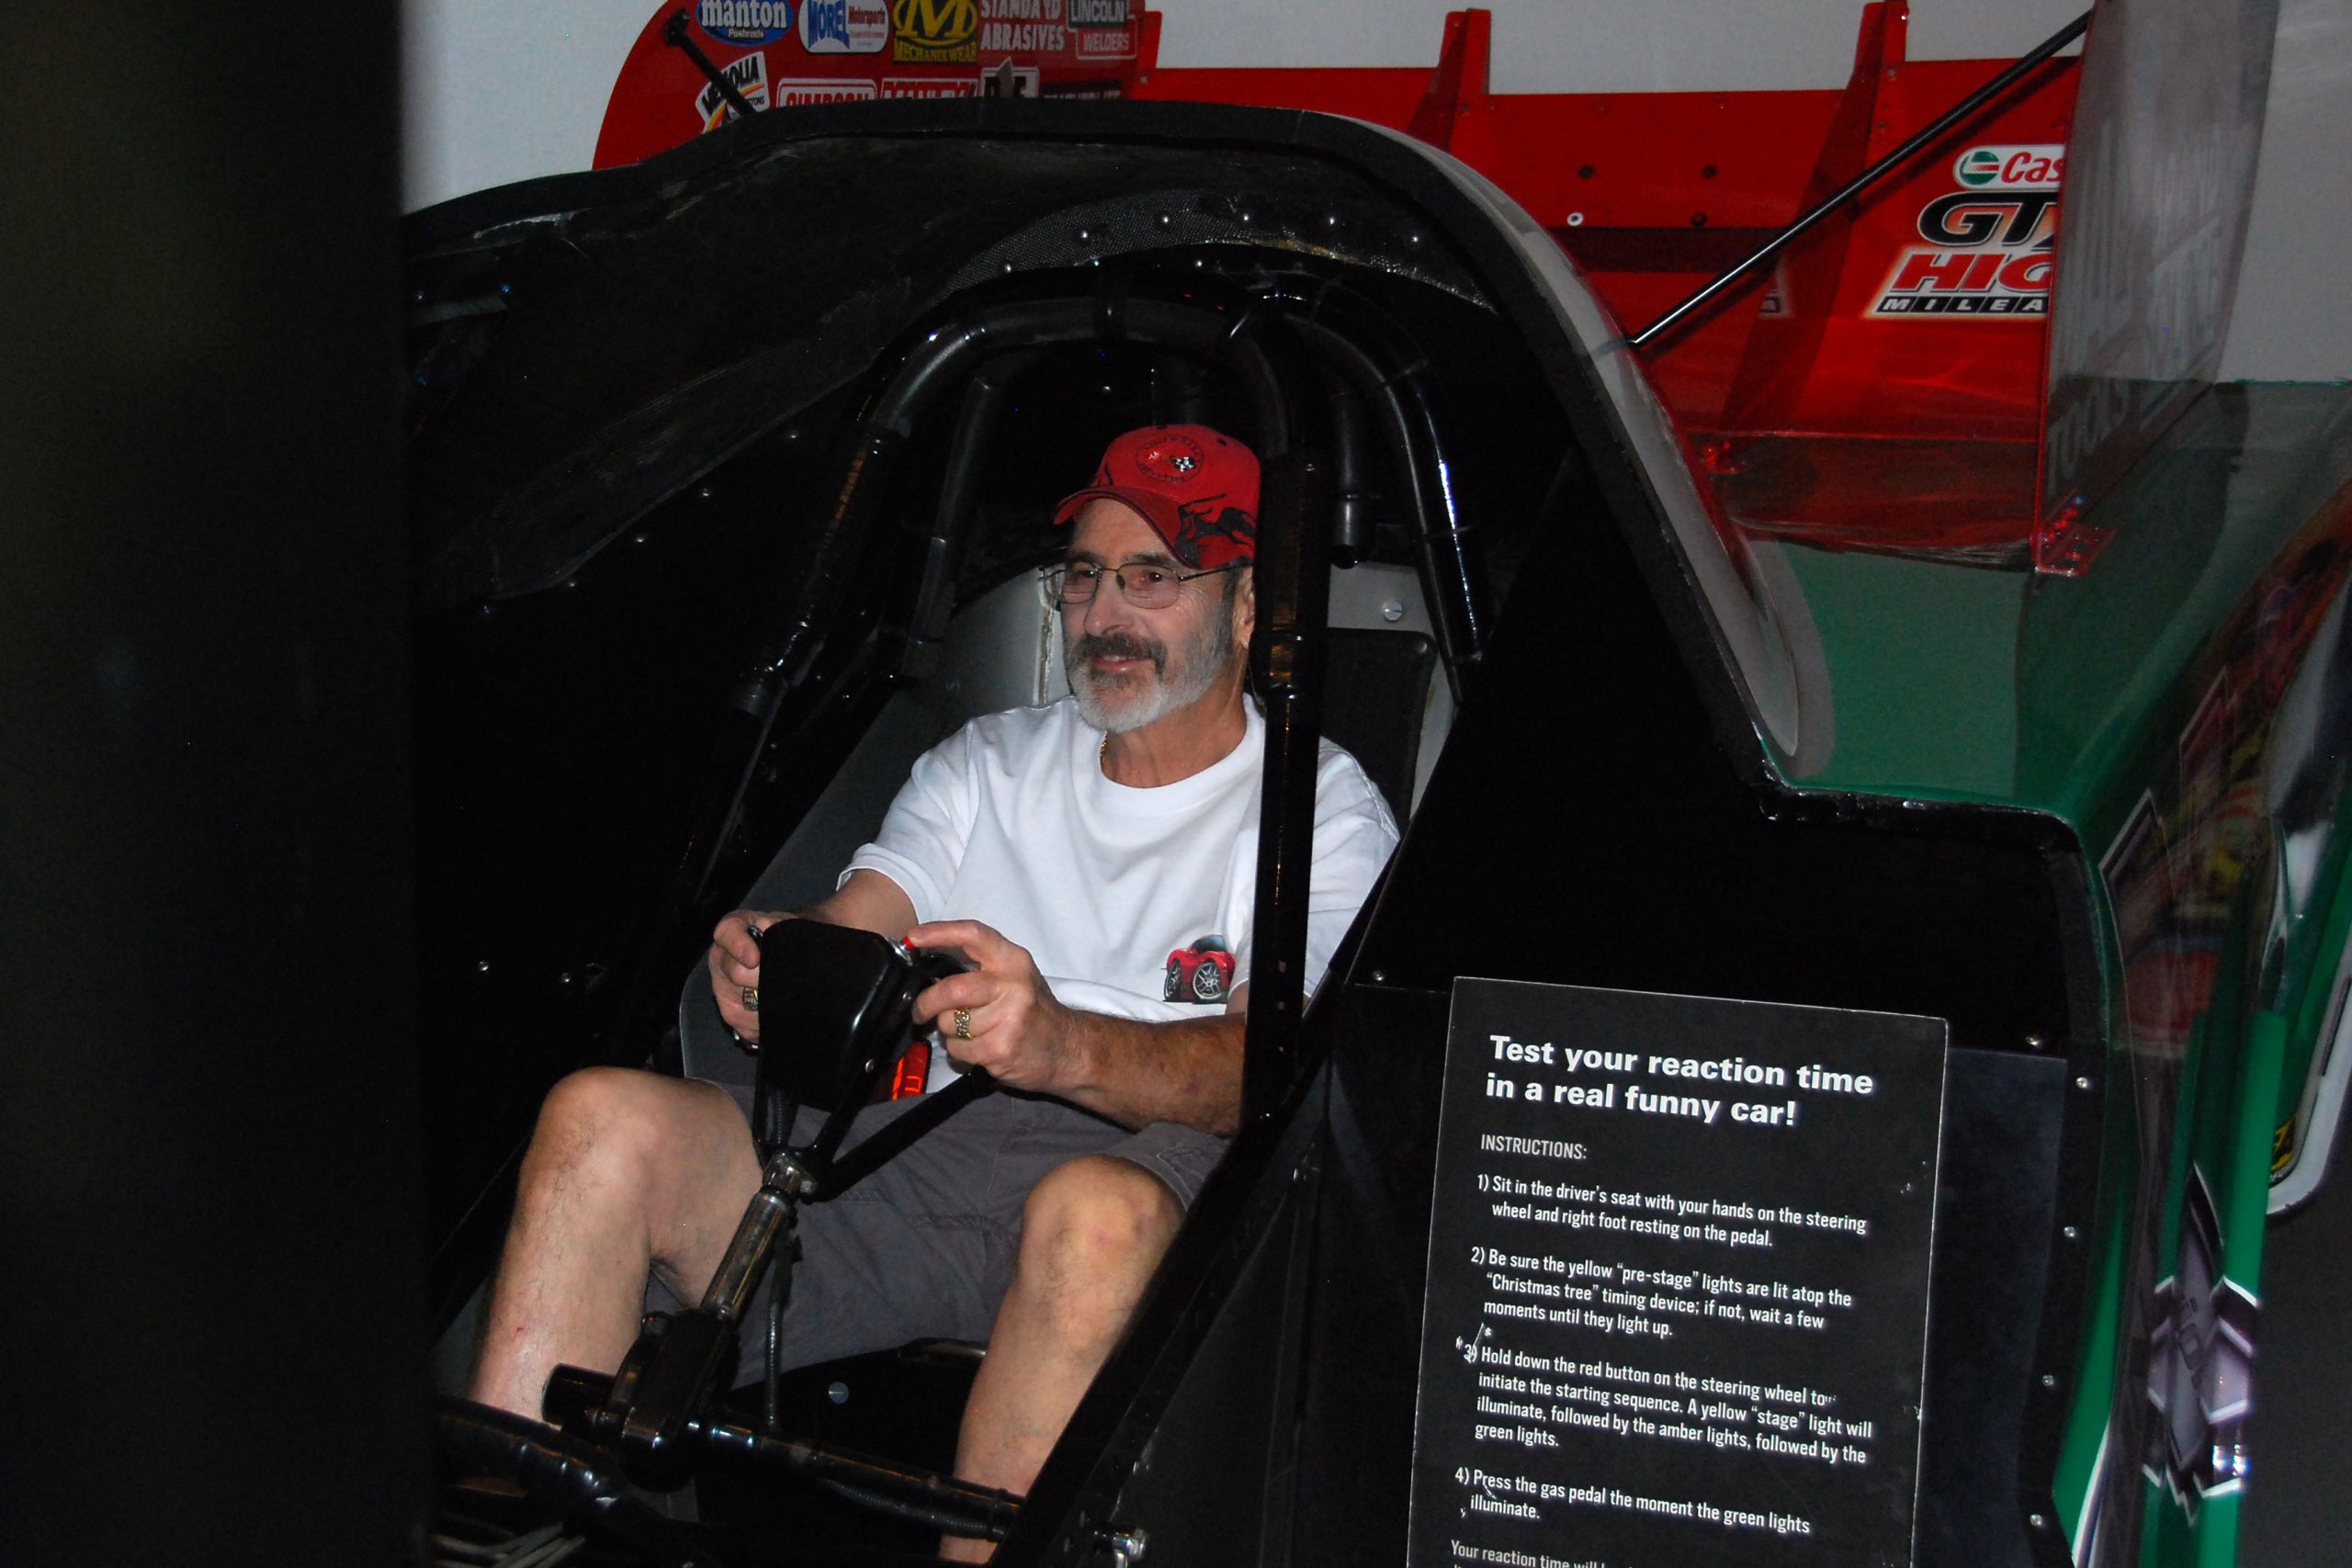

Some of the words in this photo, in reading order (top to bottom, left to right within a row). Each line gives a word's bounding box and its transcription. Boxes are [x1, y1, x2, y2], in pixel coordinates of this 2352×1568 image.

[980, 22, 1066, 51] ABRASIVES
[1070, 0, 1125, 23] LINCOLN
[1083, 32, 1130, 52] WELDERS
[1917, 190, 2059, 252] GT
[1488, 1033, 1555, 1066] Test
[1564, 1045, 1640, 1073] your
[1647, 1055, 1786, 1087] reaction
[1795, 1063, 1875, 1095] time
[1485, 1071, 1515, 1099] in
[1523, 1081, 1544, 1101] a
[1553, 1082, 1615, 1109] real
[1623, 1084, 1721, 1124] funny
[1729, 1100, 1797, 1126] car!
[1480, 1133, 1588, 1160] INSTRUCTIONS:
[1476, 1173, 1489, 1192] 1)
[1491, 1174, 1512, 1193] Sit
[1514, 1179, 1528, 1195] in
[1530, 1179, 1554, 1198] the
[1555, 1181, 1608, 1203] driver’s
[1610, 1191, 1642, 1207] seat
[1644, 1193, 1676, 1211] with
[1677, 1199, 1710, 1216] your
[1711, 1198, 1755, 1220] hands
[1757, 1207, 1776, 1222] on
[1778, 1205, 1803, 1225] the
[1804, 1211, 1868, 1235] steering
[1491, 1200, 1532, 1220] wheel
[1533, 1205, 1559, 1223] and
[1561, 1209, 1596, 1229] right
[1597, 1211, 1627, 1231] foot
[1629, 1218, 1680, 1240] resting
[1682, 1224, 1701, 1239] on
[1702, 1223, 1728, 1242] the
[1729, 1227, 1773, 1247] pedal.
[1470, 1246, 1486, 1265] 2)
[1487, 1247, 1507, 1267] Be
[1509, 1255, 1540, 1270] sure
[1542, 1254, 1566, 1273] the
[1566, 1258, 1613, 1279] yellow
[1616, 1261, 1700, 1291] “pre-stage”
[1701, 1272, 1743, 1295] lights
[1745, 1282, 1770, 1297] are
[1772, 1280, 1789, 1300] lit
[1791, 1285, 1826, 1308] atop
[1826, 1288, 1852, 1307] the
[1486, 1271, 1561, 1297] “Christmas
[1563, 1282, 1600, 1302] tree”
[1600, 1287, 1647, 1311] timing
[1648, 1292, 1700, 1315] device;
[1703, 1298, 1716, 1316] if
[1717, 1303, 1746, 1323] not,
[1748, 1307, 1781, 1324] wait
[1782, 1312, 1794, 1325] a
[1796, 1309, 1825, 1329] few
[1483, 1301, 1546, 1321] moments
[1548, 1307, 1580, 1325] until
[1582, 1309, 1614, 1333] they
[1616, 1312, 1649, 1335] light
[1651, 1322, 1673, 1340] up.
[1480, 1345, 1511, 1366] Hold
[1513, 1349, 1551, 1371] down
[1553, 1355, 1577, 1374] the
[1578, 1359, 1602, 1378] red
[1604, 1361, 1650, 1384] button
[1653, 1372, 1671, 1386] on
[1673, 1371, 1698, 1391] the
[1700, 1376, 1761, 1402] steering
[1763, 1382, 1807, 1404] wheel
[1809, 1389, 1825, 1406] to
[1476, 1394, 1547, 1423] illuminate,
[1550, 1404, 1610, 1429] followed
[1611, 1412, 1630, 1436] by
[1632, 1416, 1656, 1435] the
[1657, 1421, 1703, 1441] amber
[1706, 1425, 1751, 1450] lights,
[1755, 1431, 1818, 1458] followed
[1820, 1440, 1839, 1465] by
[1841, 1444, 1867, 1464] the
[1477, 1371, 1527, 1393] initiate
[1529, 1377, 1553, 1396] the
[1555, 1382, 1611, 1407] starting
[1612, 1392, 1683, 1414] sequence.
[1686, 1397, 1698, 1416] A
[1700, 1401, 1747, 1422] yellow
[1750, 1404, 1805, 1431] “stage”
[1808, 1413, 1843, 1437] light
[1845, 1420, 1872, 1438] will
[1474, 1423, 1514, 1440] green
[1516, 1424, 1559, 1447] lights.
[1453, 1466, 1470, 1485] 4)
[1472, 1468, 1511, 1489] Press
[1514, 1475, 1537, 1495] the
[1539, 1483, 1566, 1499] gas
[1567, 1484, 1607, 1506] pedal
[1609, 1488, 1633, 1508] the
[1634, 1496, 1693, 1517] moment
[1695, 1501, 1721, 1521] the
[1722, 1509, 1765, 1528] green
[1768, 1510, 1811, 1534] lights
[1469, 1492, 1540, 1519] illuminate.
[1451, 1540, 1479, 1559] Your
[1482, 1548, 1536, 1568] reaction
